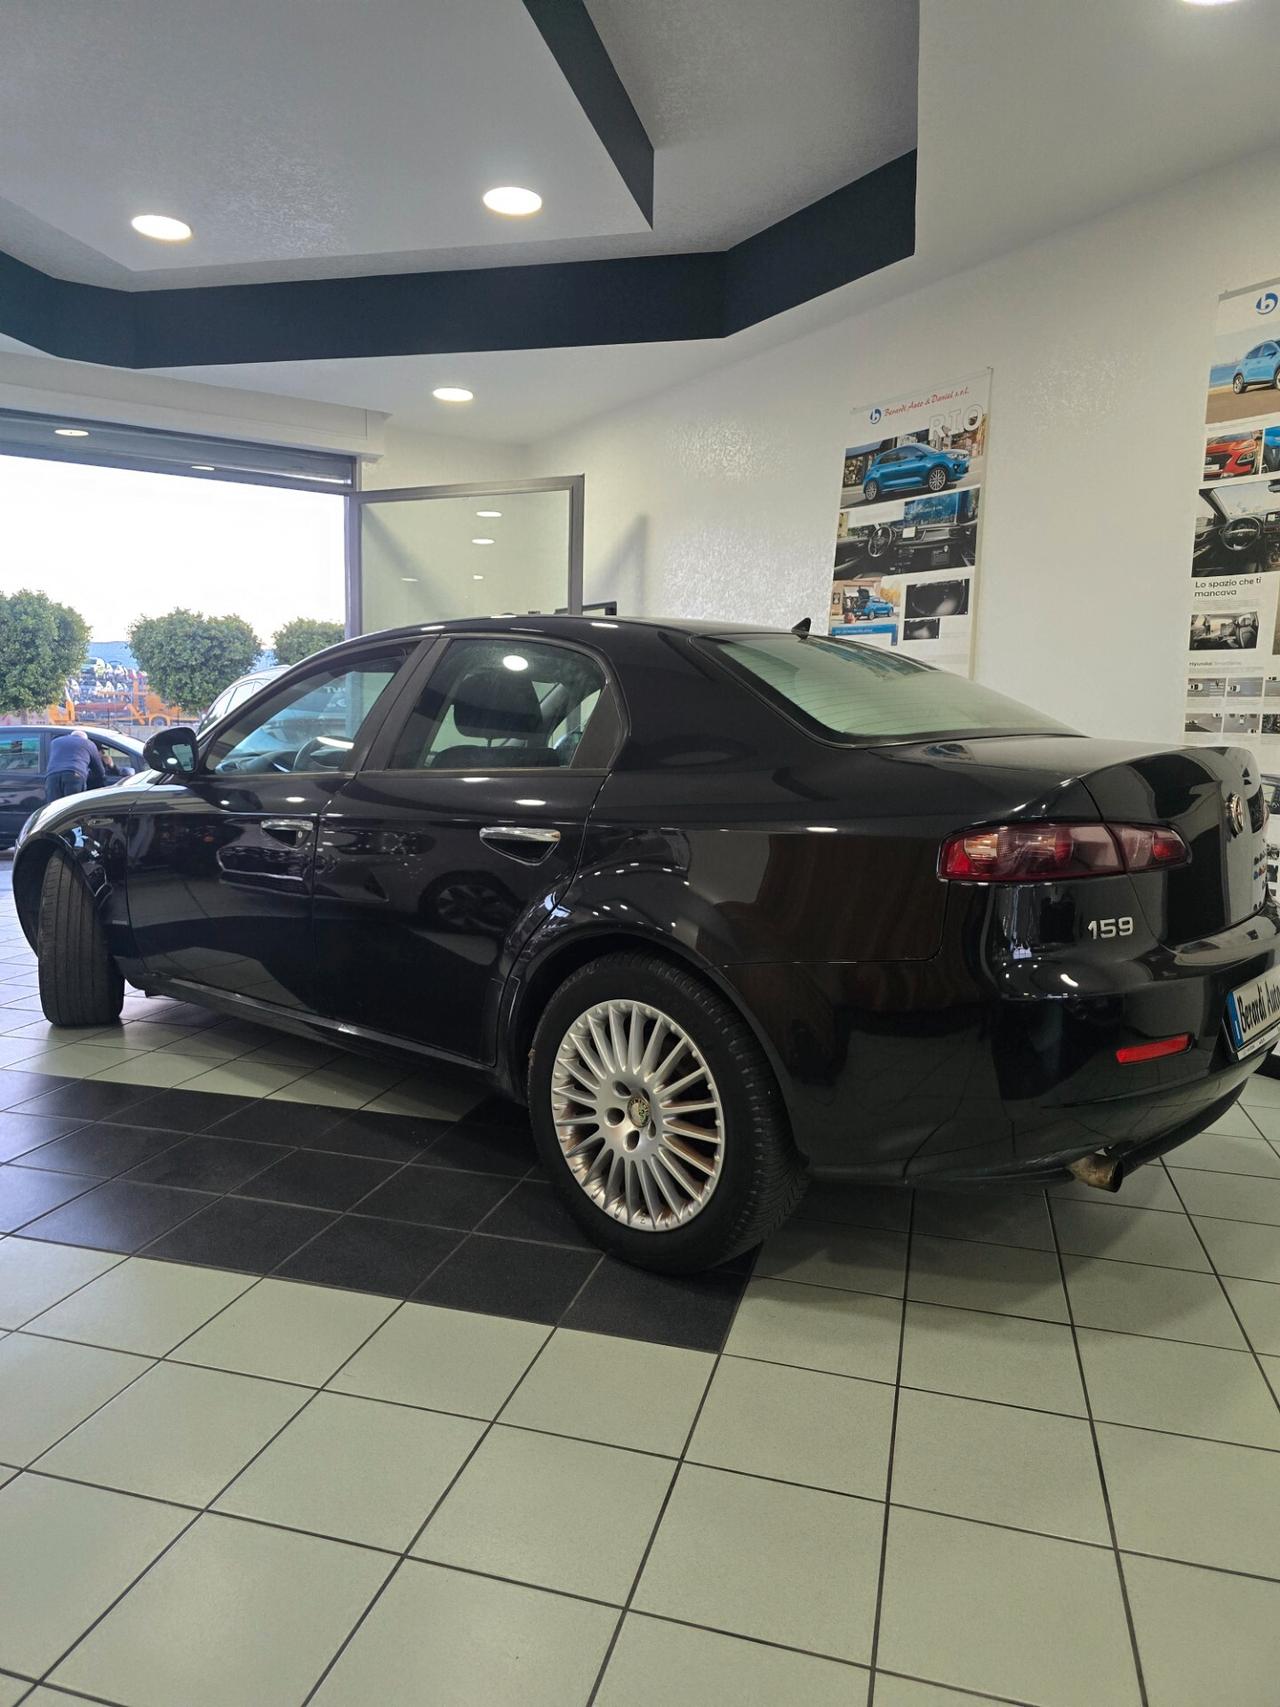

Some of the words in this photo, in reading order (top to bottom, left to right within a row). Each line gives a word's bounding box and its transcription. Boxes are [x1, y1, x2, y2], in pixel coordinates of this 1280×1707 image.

[928, 404, 984, 441] RIO
[1194, 589, 1237, 597] mancava
[1208, 578, 1237, 589] spazio
[1239, 577, 1254, 586] che
[1256, 576, 1262, 584] ti
[1087, 916, 1134, 940] 159
[1236, 983, 1268, 1034] Berardi
